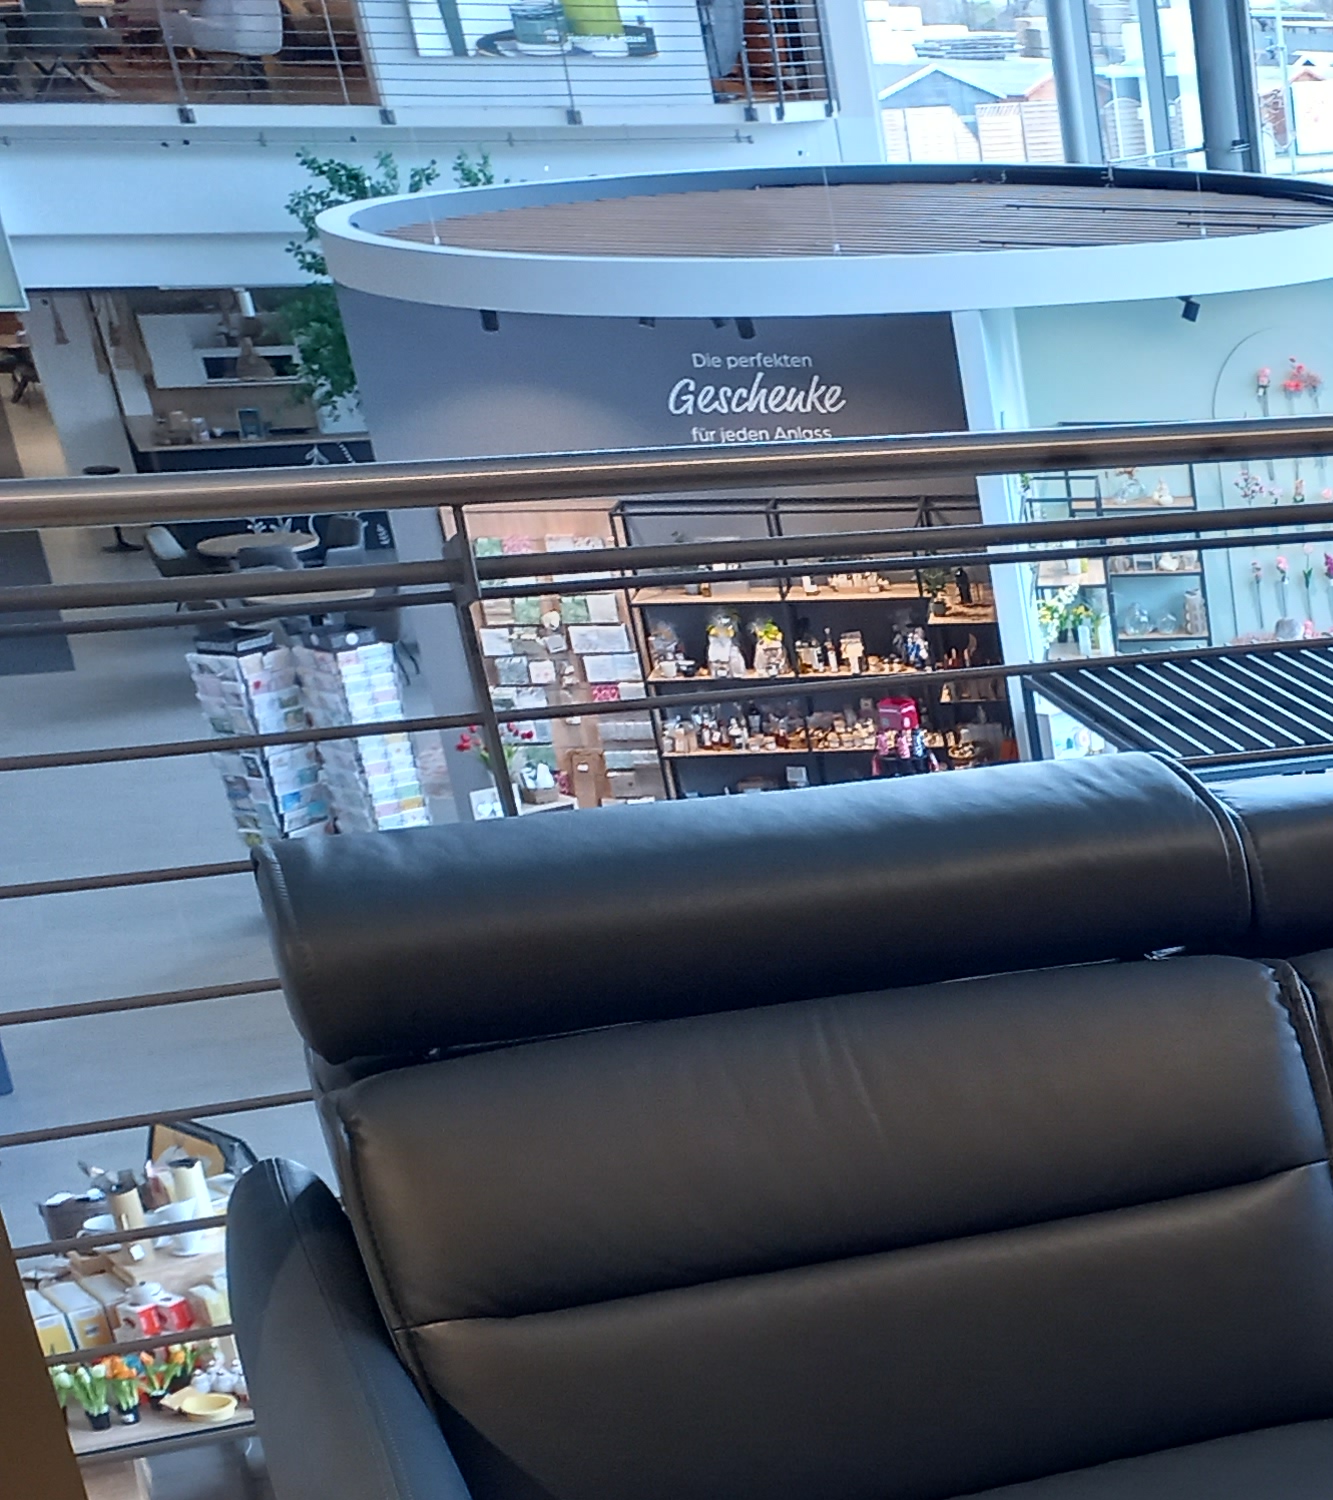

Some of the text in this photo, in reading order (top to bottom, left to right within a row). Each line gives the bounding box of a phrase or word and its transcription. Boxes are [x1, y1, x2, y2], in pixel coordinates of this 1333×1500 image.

[691, 352, 813, 370] Die perfekten
[668, 372, 847, 415] Geschenke
[691, 426, 833, 443] für jeden Anlass
